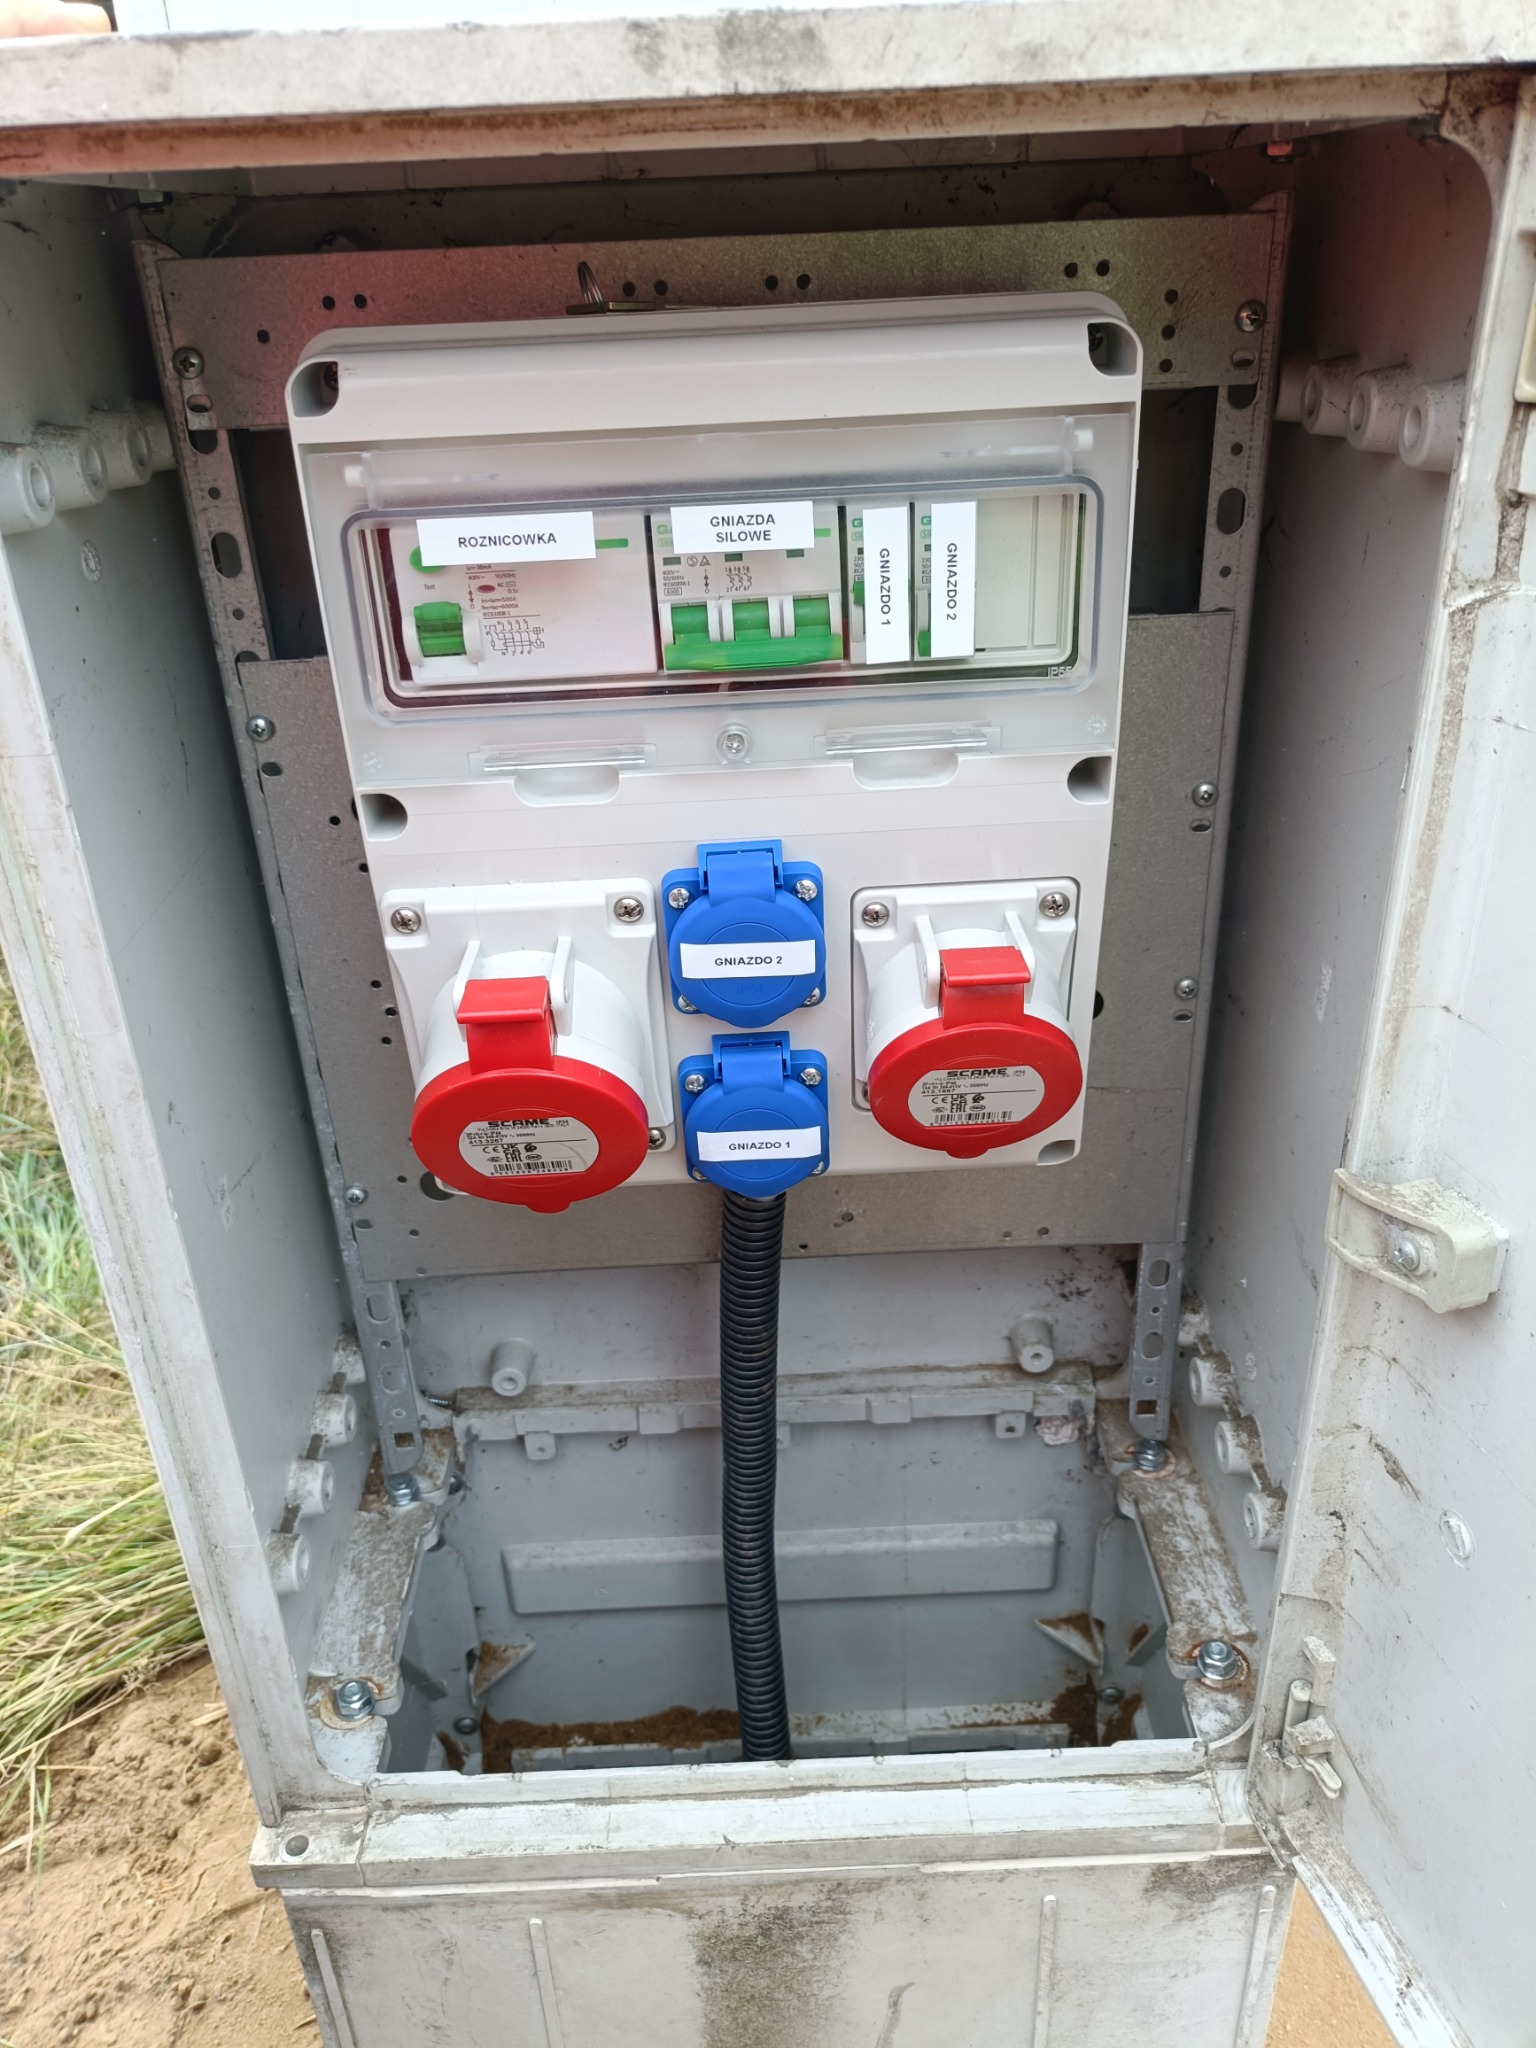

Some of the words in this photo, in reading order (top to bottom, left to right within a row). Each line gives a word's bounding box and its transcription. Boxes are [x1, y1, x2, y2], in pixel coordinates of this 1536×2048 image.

[709, 513, 776, 528] GNIAZDA
[457, 532, 557, 548] ROZNICOWKA
[715, 530, 772, 543] SILOWE
[879, 548, 891, 615] GNIAZDO
[946, 542, 958, 609] GNIAZDO
[946, 613, 957, 621] 2
[714, 956, 773, 966] GNIAZDO
[776, 955, 783, 965] 2
[946, 1068, 1008, 1078] SCAME
[487, 1118, 550, 1128] SCAME
[728, 1141, 782, 1150] GNIAZDO
[785, 1141, 791, 1149] 1
